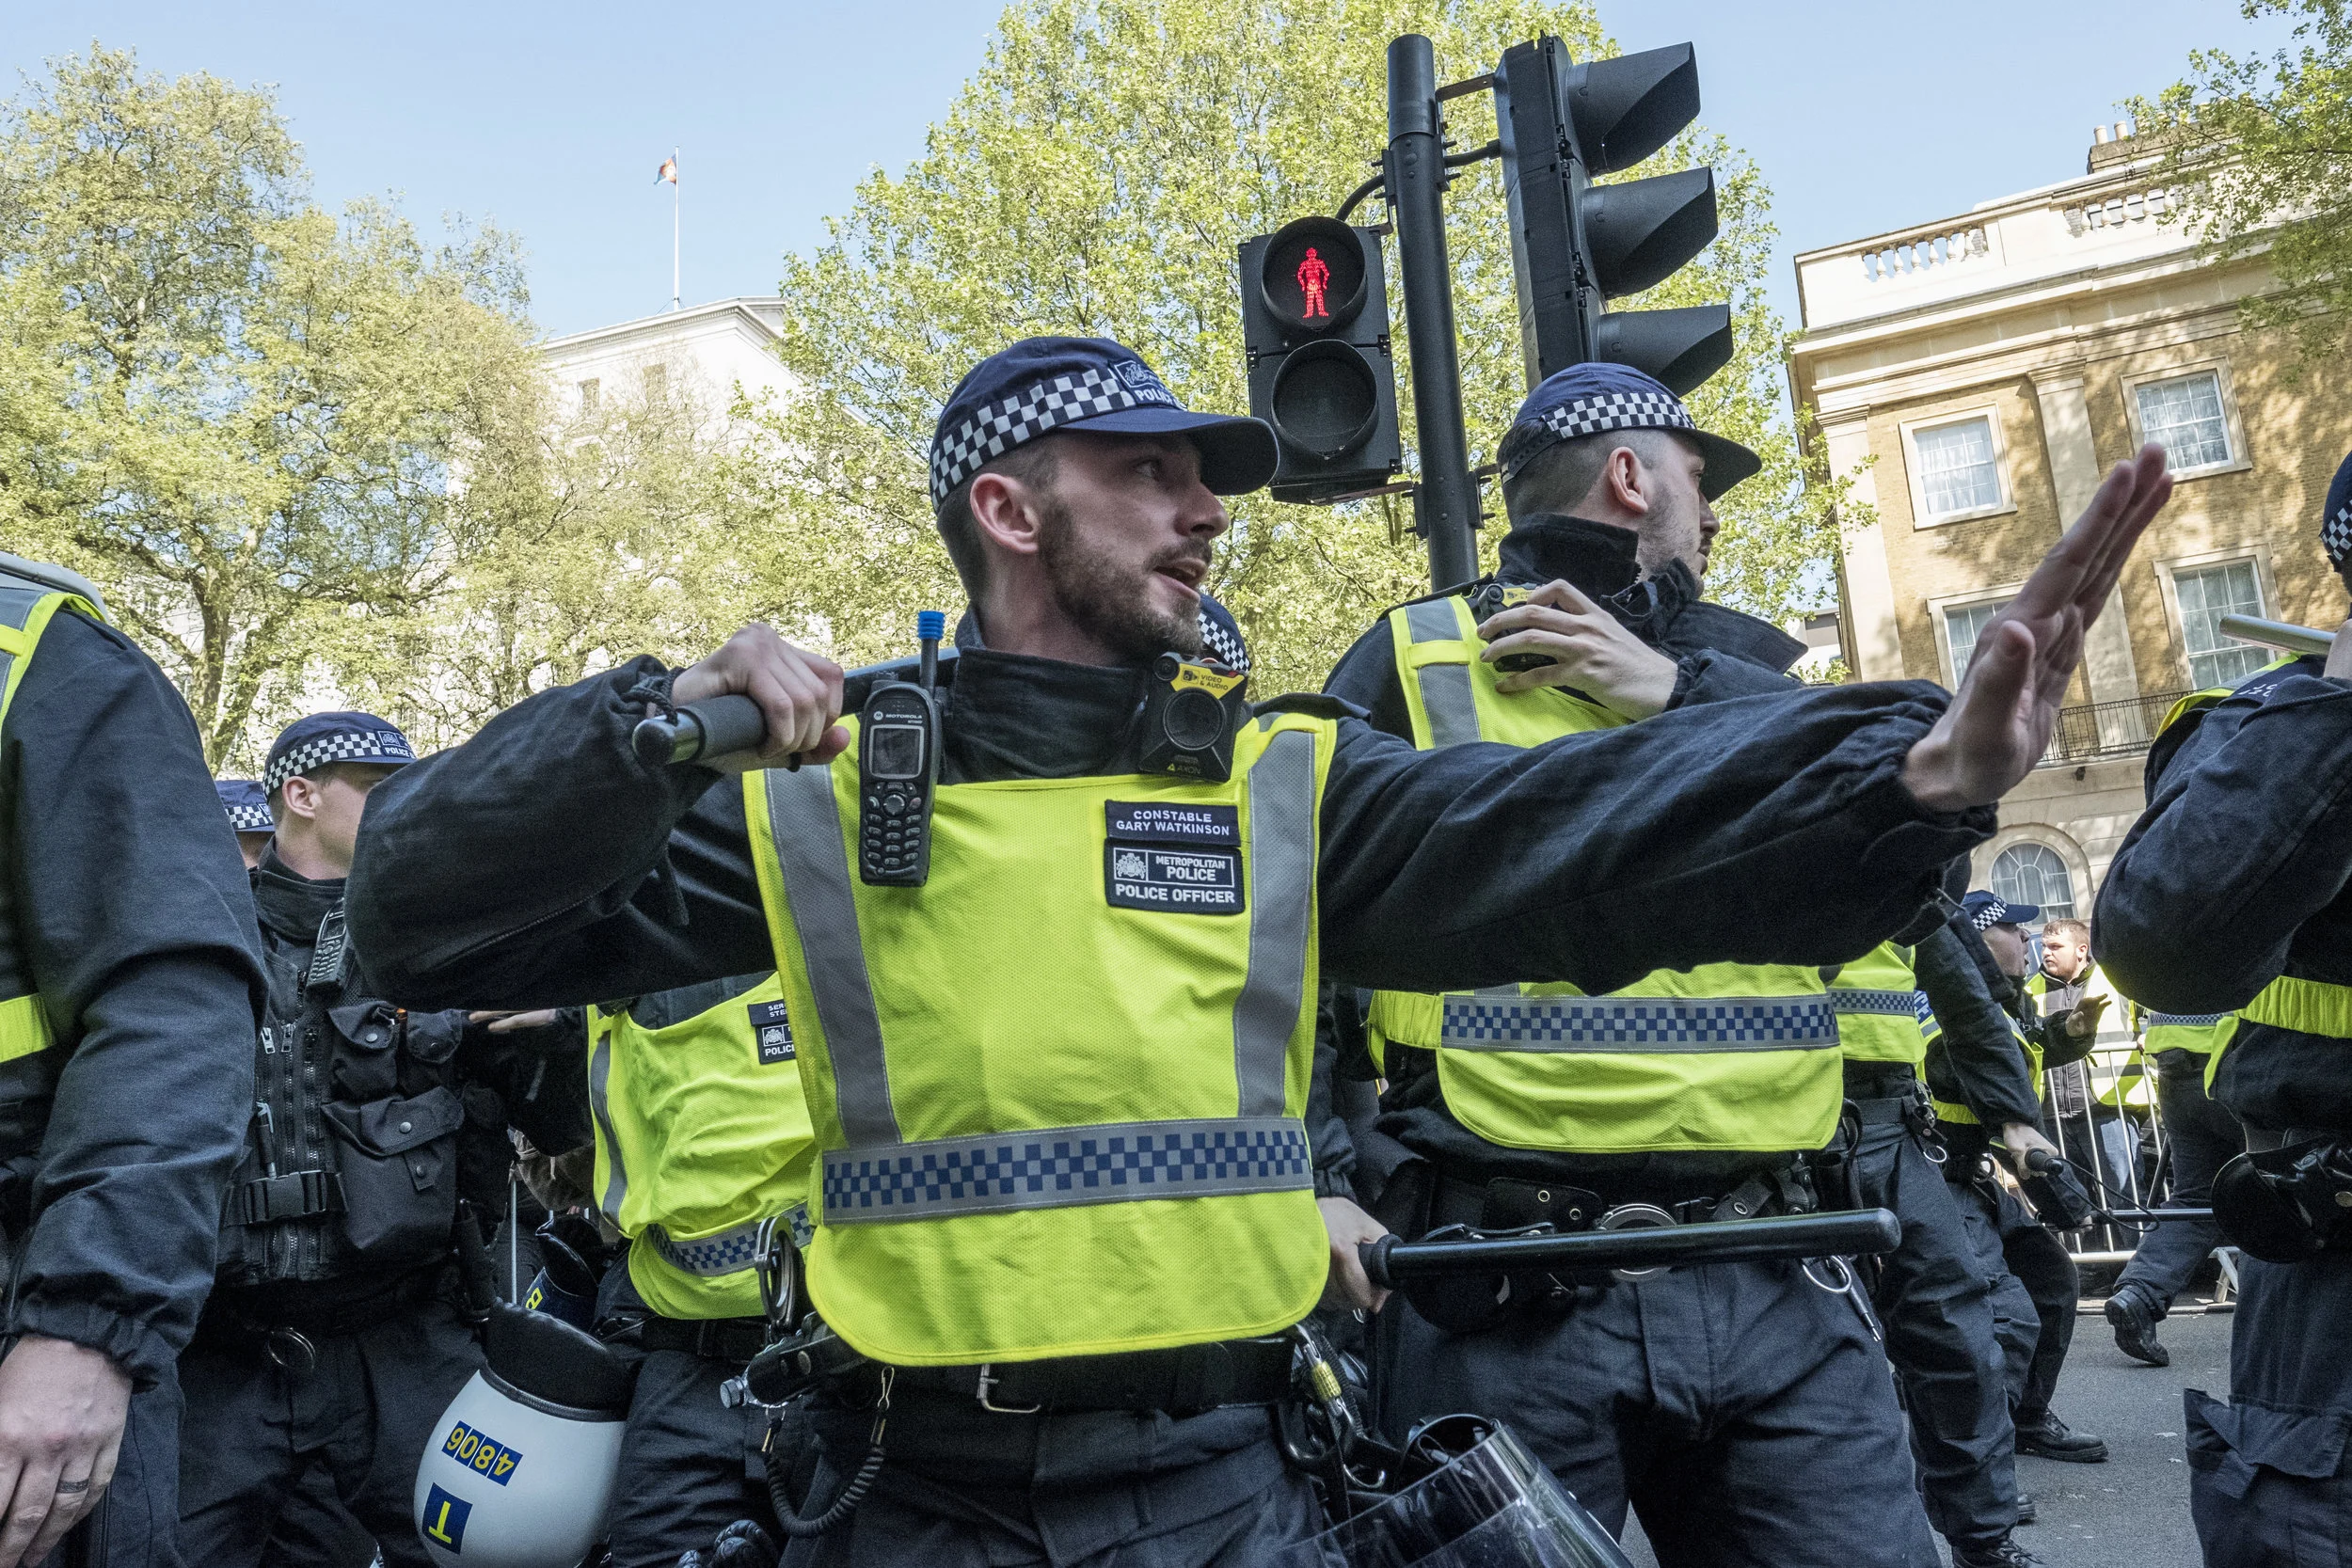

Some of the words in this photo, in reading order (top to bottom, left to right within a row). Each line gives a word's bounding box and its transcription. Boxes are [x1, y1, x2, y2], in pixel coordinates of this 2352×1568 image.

[1201, 674, 1222, 683] VIDEO
[1206, 682, 1229, 690] AUDIO
[1134, 810, 1212, 823] CONSTABLE
[1116, 820, 1151, 832] GARY
[1154, 821, 1230, 835] WATKINSON
[1155, 855, 1226, 869] METROPOLITAN
[1167, 866, 1216, 881] POLICE
[1115, 883, 1168, 901] POLICE
[1172, 888, 1235, 903] OFFICER
[768, 1003, 787, 1011] SER
[770, 1009, 787, 1018] STE
[446, 1427, 516, 1476] 4806
[428, 1500, 452, 1544] T
